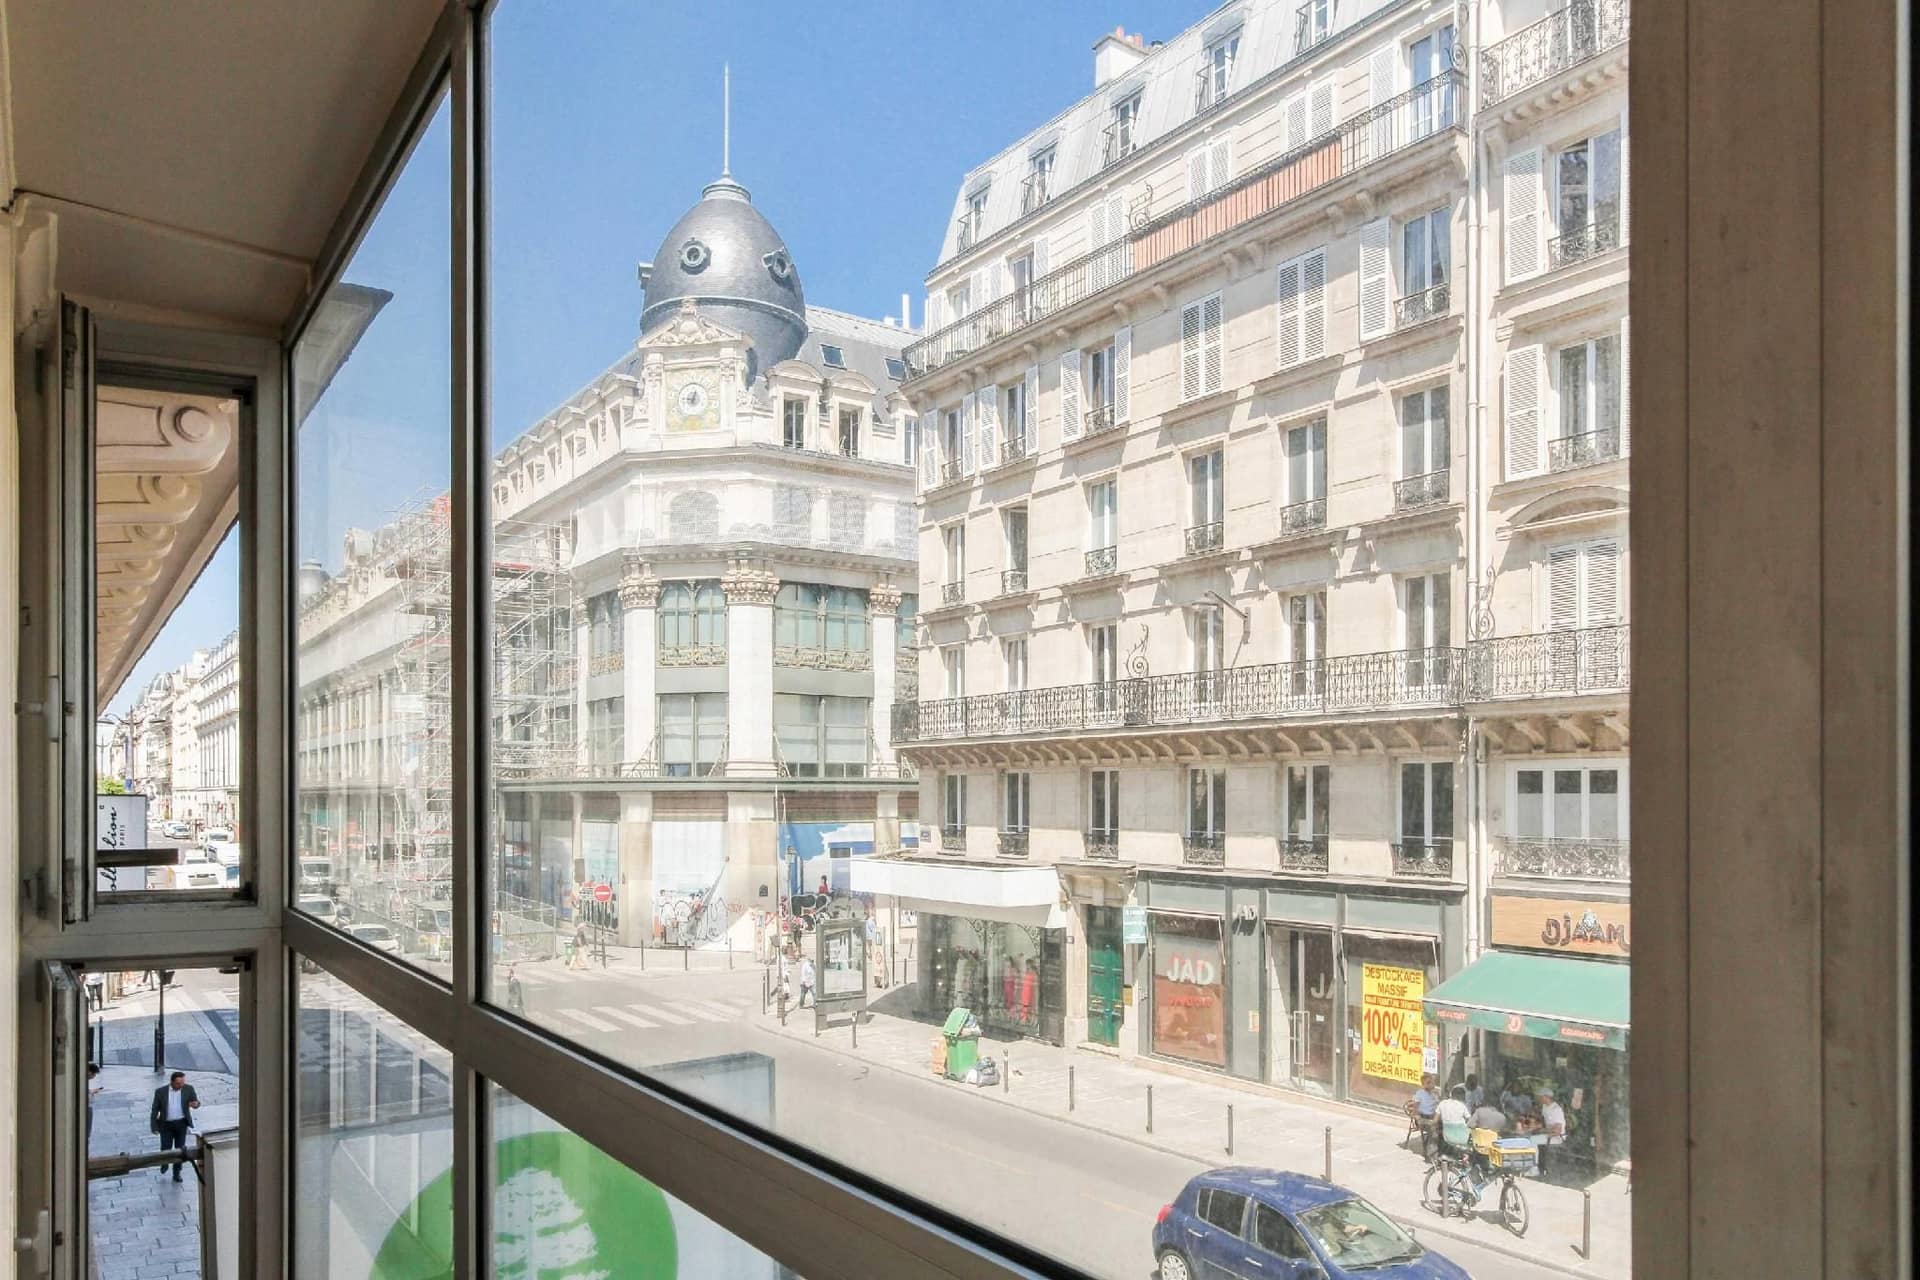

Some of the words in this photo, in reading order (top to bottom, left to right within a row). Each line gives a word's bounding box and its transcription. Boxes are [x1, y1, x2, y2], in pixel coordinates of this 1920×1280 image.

[1166, 957, 1215, 986] JAD
[1365, 966, 1422, 984] DESTOCKAGE
[1377, 982, 1408, 997] MASSIF
[1364, 1007, 1409, 1050] 100%
[1382, 1050, 1401, 1065] DOIT
